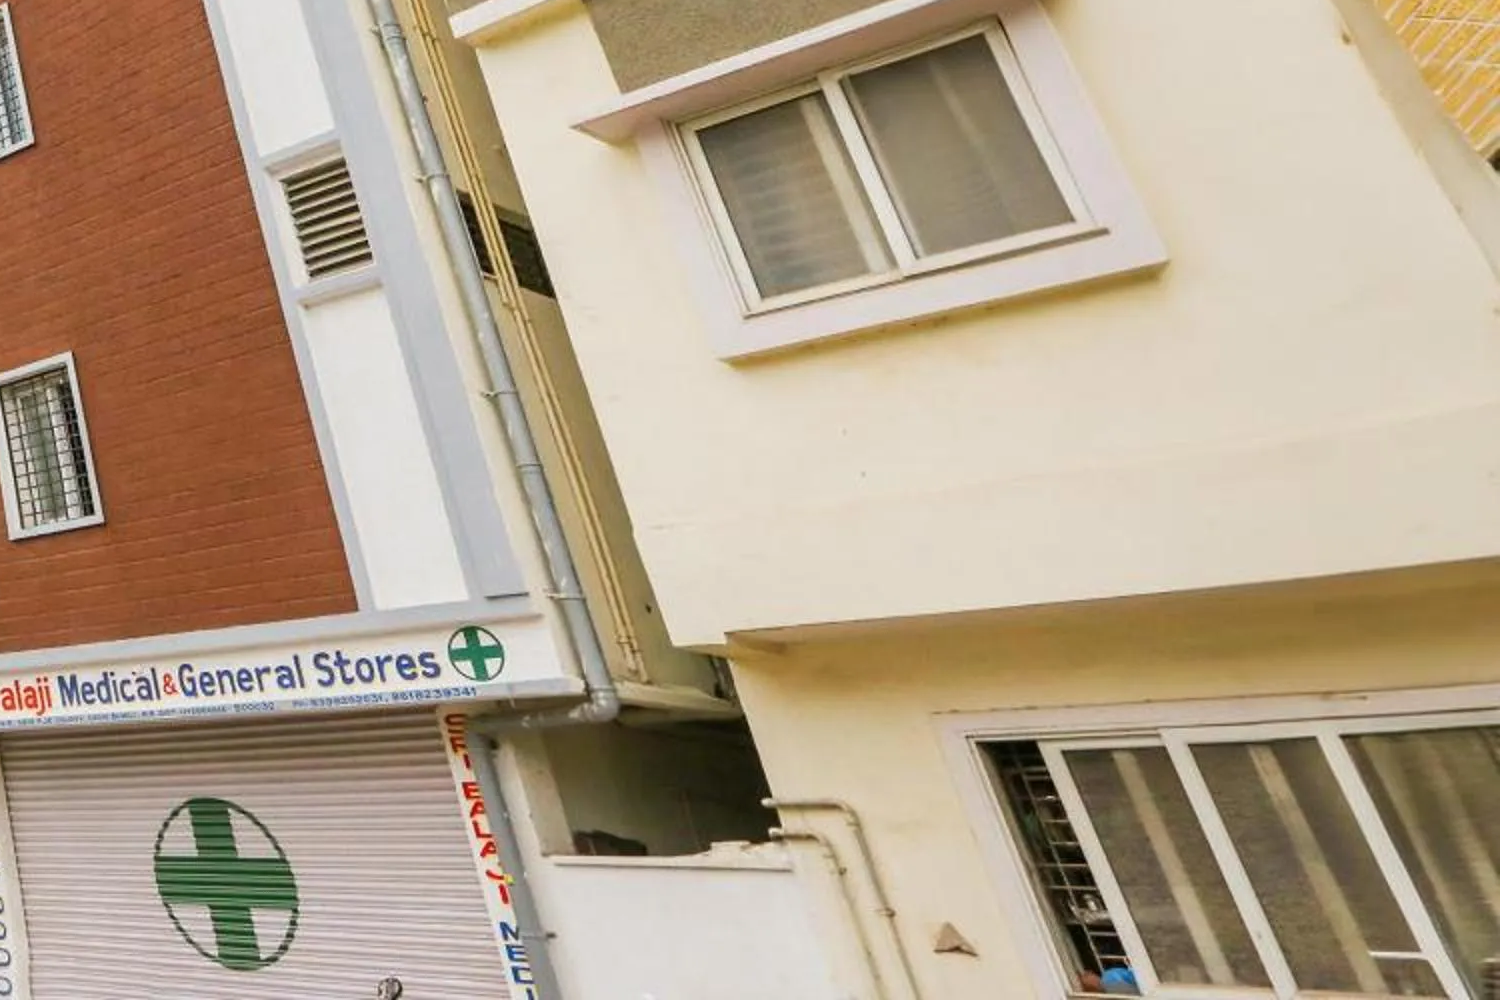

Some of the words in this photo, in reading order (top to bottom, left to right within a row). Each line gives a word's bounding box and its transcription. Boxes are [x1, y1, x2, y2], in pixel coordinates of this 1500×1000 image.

[57, 665, 161, 707] Medical
[178, 655, 305, 699] General
[312, 650, 442, 688] Stores
